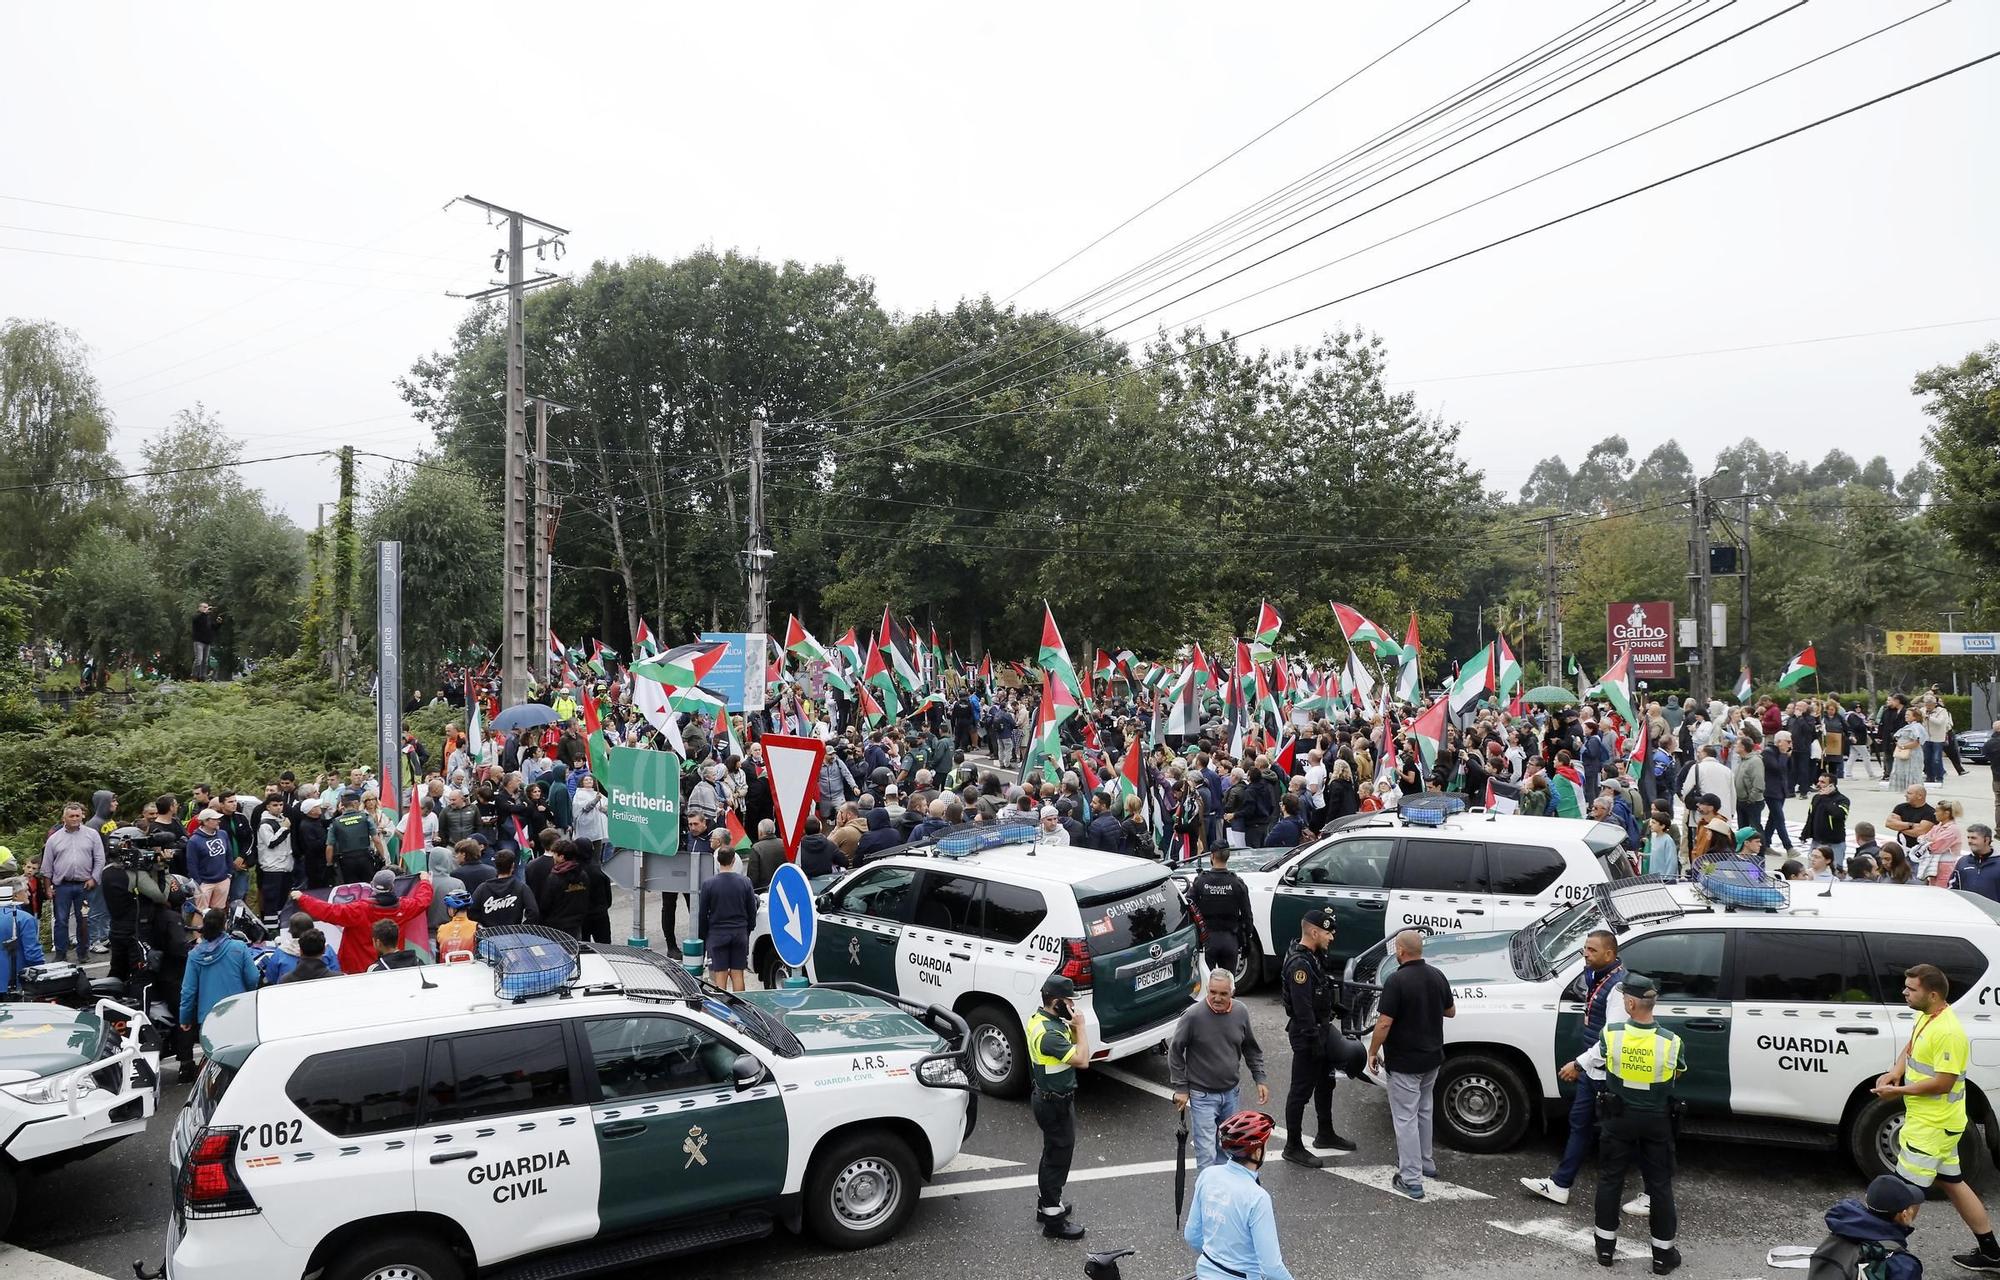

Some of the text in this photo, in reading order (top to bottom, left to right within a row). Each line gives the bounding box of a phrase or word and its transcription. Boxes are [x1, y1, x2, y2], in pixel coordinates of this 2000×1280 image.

[1613, 624, 1664, 639] Garbo
[383, 627, 397, 665] galicia
[1613, 654, 1666, 662] AURANT
[383, 713, 397, 751] galicia
[612, 788, 674, 813] Fertiberia
[612, 809, 649, 825] Fertilizantes
[1204, 883, 1232, 891] GUARDIA
[1565, 885, 1590, 900] 062
[1106, 892, 1167, 919] GUARDIA CIVIL
[1402, 913, 1462, 929] GUARDIA
[1038, 935, 1061, 954] 062
[908, 952, 952, 974] GUARDIA
[919, 970, 942, 987] CIVIL
[1137, 975, 1151, 987] PGC
[1152, 968, 1166, 983] 9977
[1452, 987, 1487, 999] A.R.S.
[1621, 1047, 1654, 1057] GUARDIA
[1757, 1035, 1849, 1055] GUARDIA
[852, 1055, 889, 1072] A.R.S.
[1628, 1055, 1646, 1063] CIVIL
[1778, 1056, 1829, 1073] CIVIL
[814, 1072, 874, 1087] GUARDIA CIVIL
[260, 1119, 303, 1148] 062
[467, 1149, 571, 1185] GUARDIA
[492, 1177, 548, 1203] CIVIL
